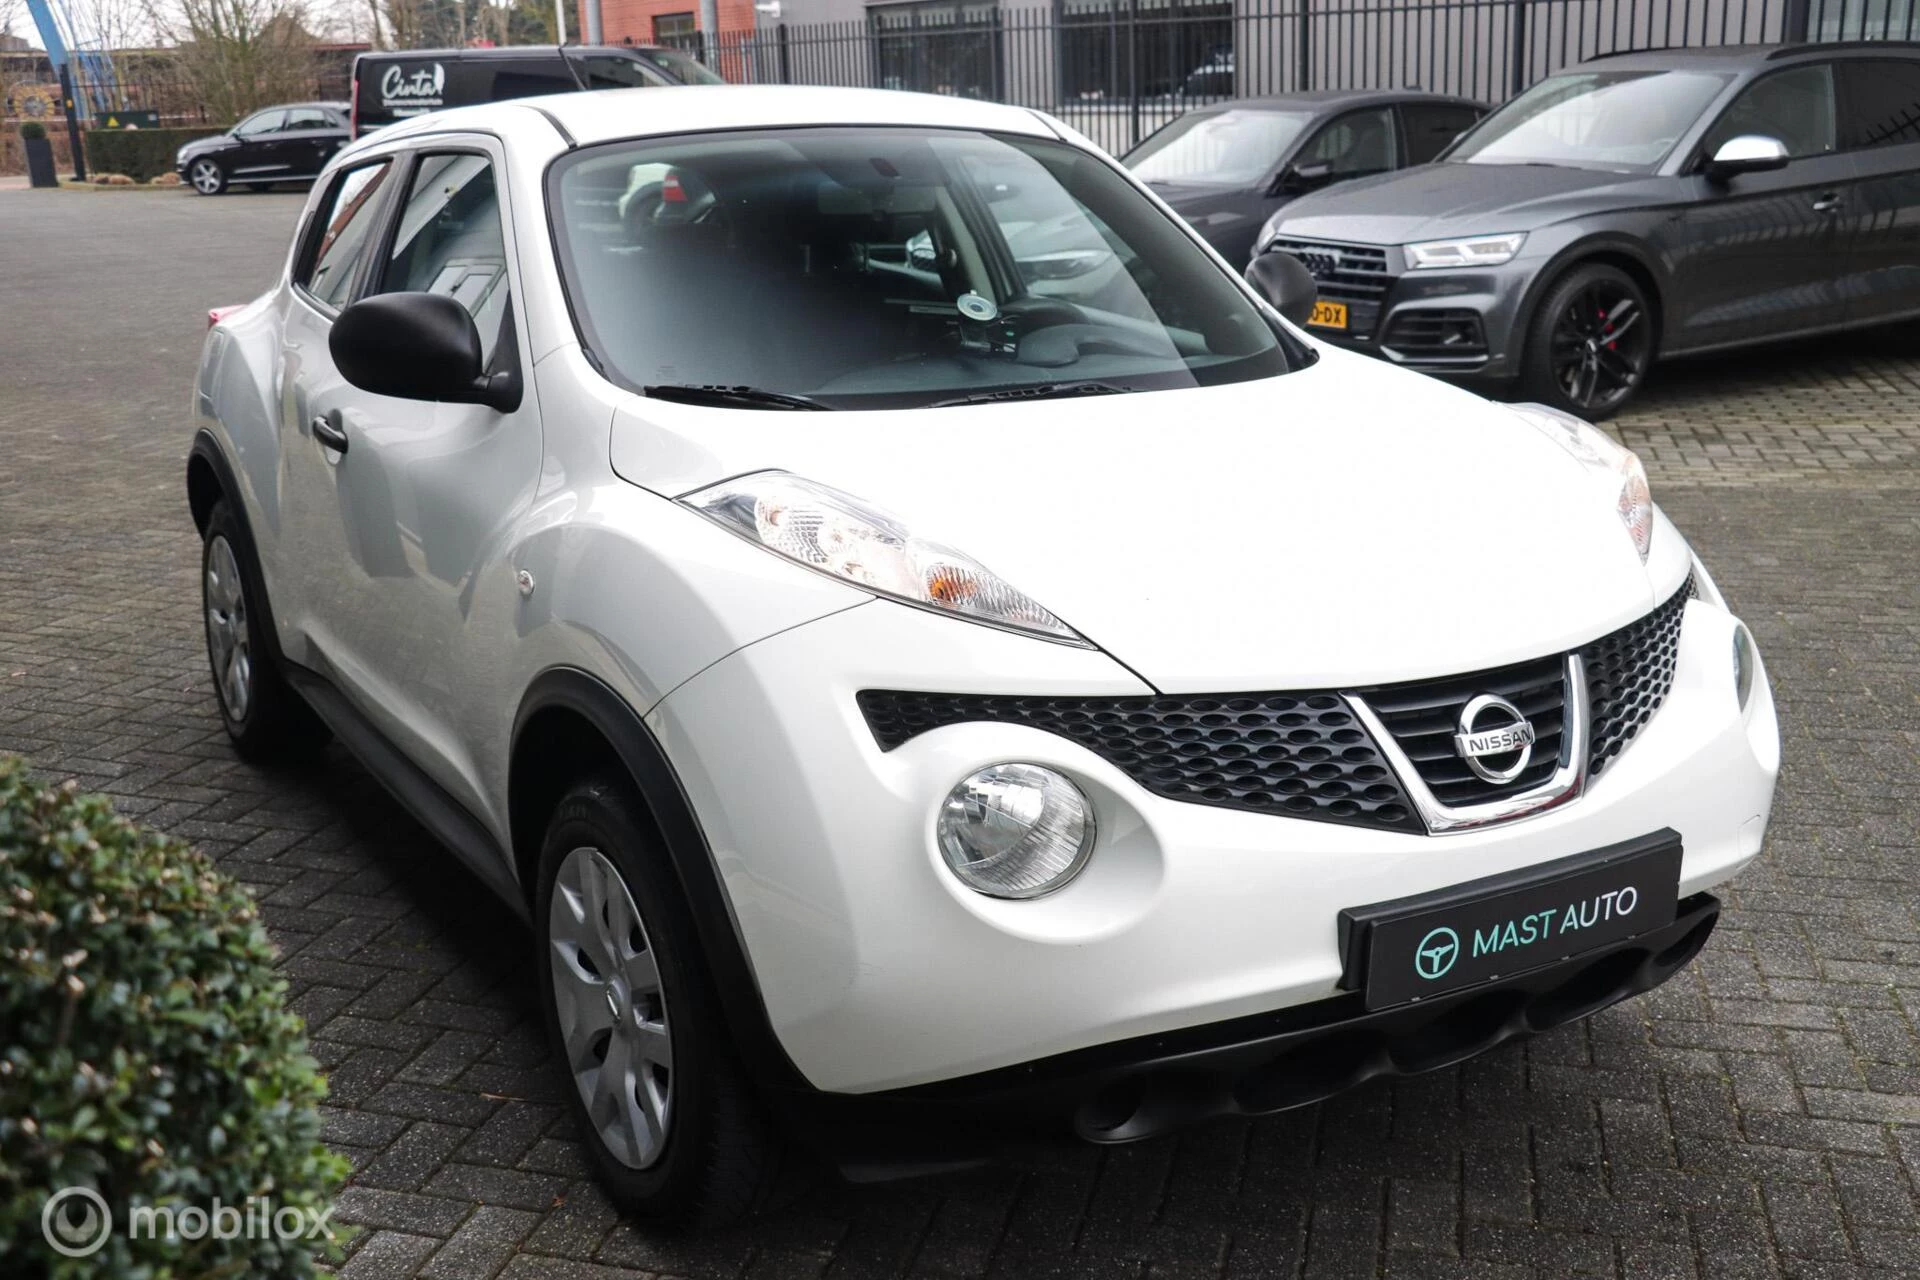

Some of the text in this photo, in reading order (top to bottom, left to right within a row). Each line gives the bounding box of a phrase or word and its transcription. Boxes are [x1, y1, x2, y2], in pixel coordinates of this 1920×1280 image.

[382, 64, 437, 99] Cinta
[1469, 729, 1532, 752] NISSAN
[1472, 886, 1638, 957] MAST AUTO
